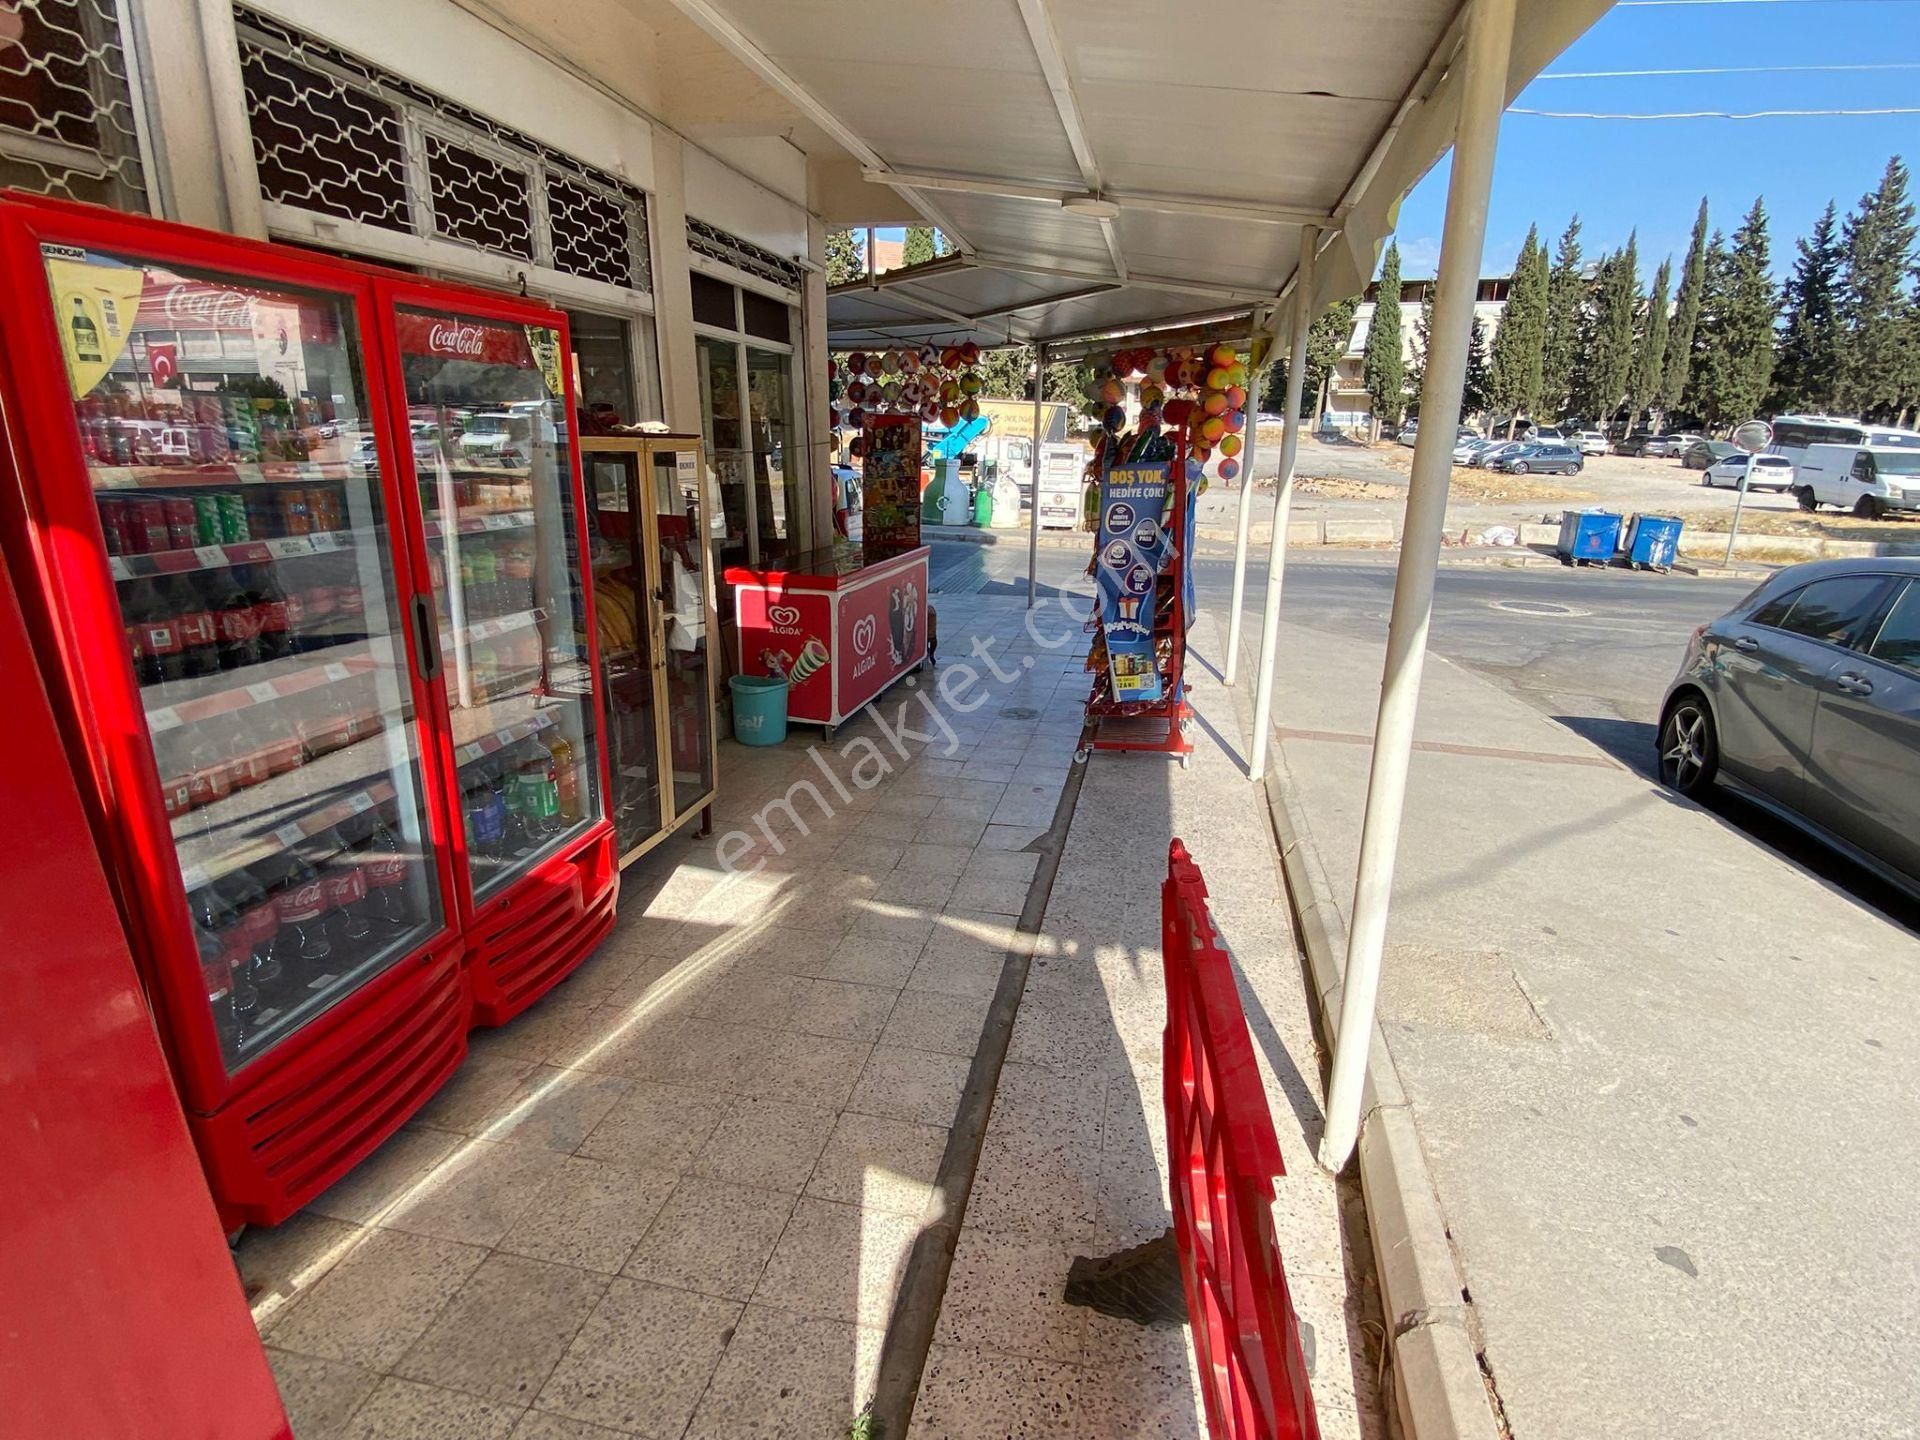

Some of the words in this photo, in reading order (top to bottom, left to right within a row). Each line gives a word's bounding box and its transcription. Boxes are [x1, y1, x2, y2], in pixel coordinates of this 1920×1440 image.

[1109, 470, 1134, 485] BOŞ
[1109, 486, 1142, 499] HEDİYE
[1143, 487, 1165, 500] ÇOK!
[769, 627, 801, 636] ALGIDA
[853, 657, 876, 680] ALGIDA
